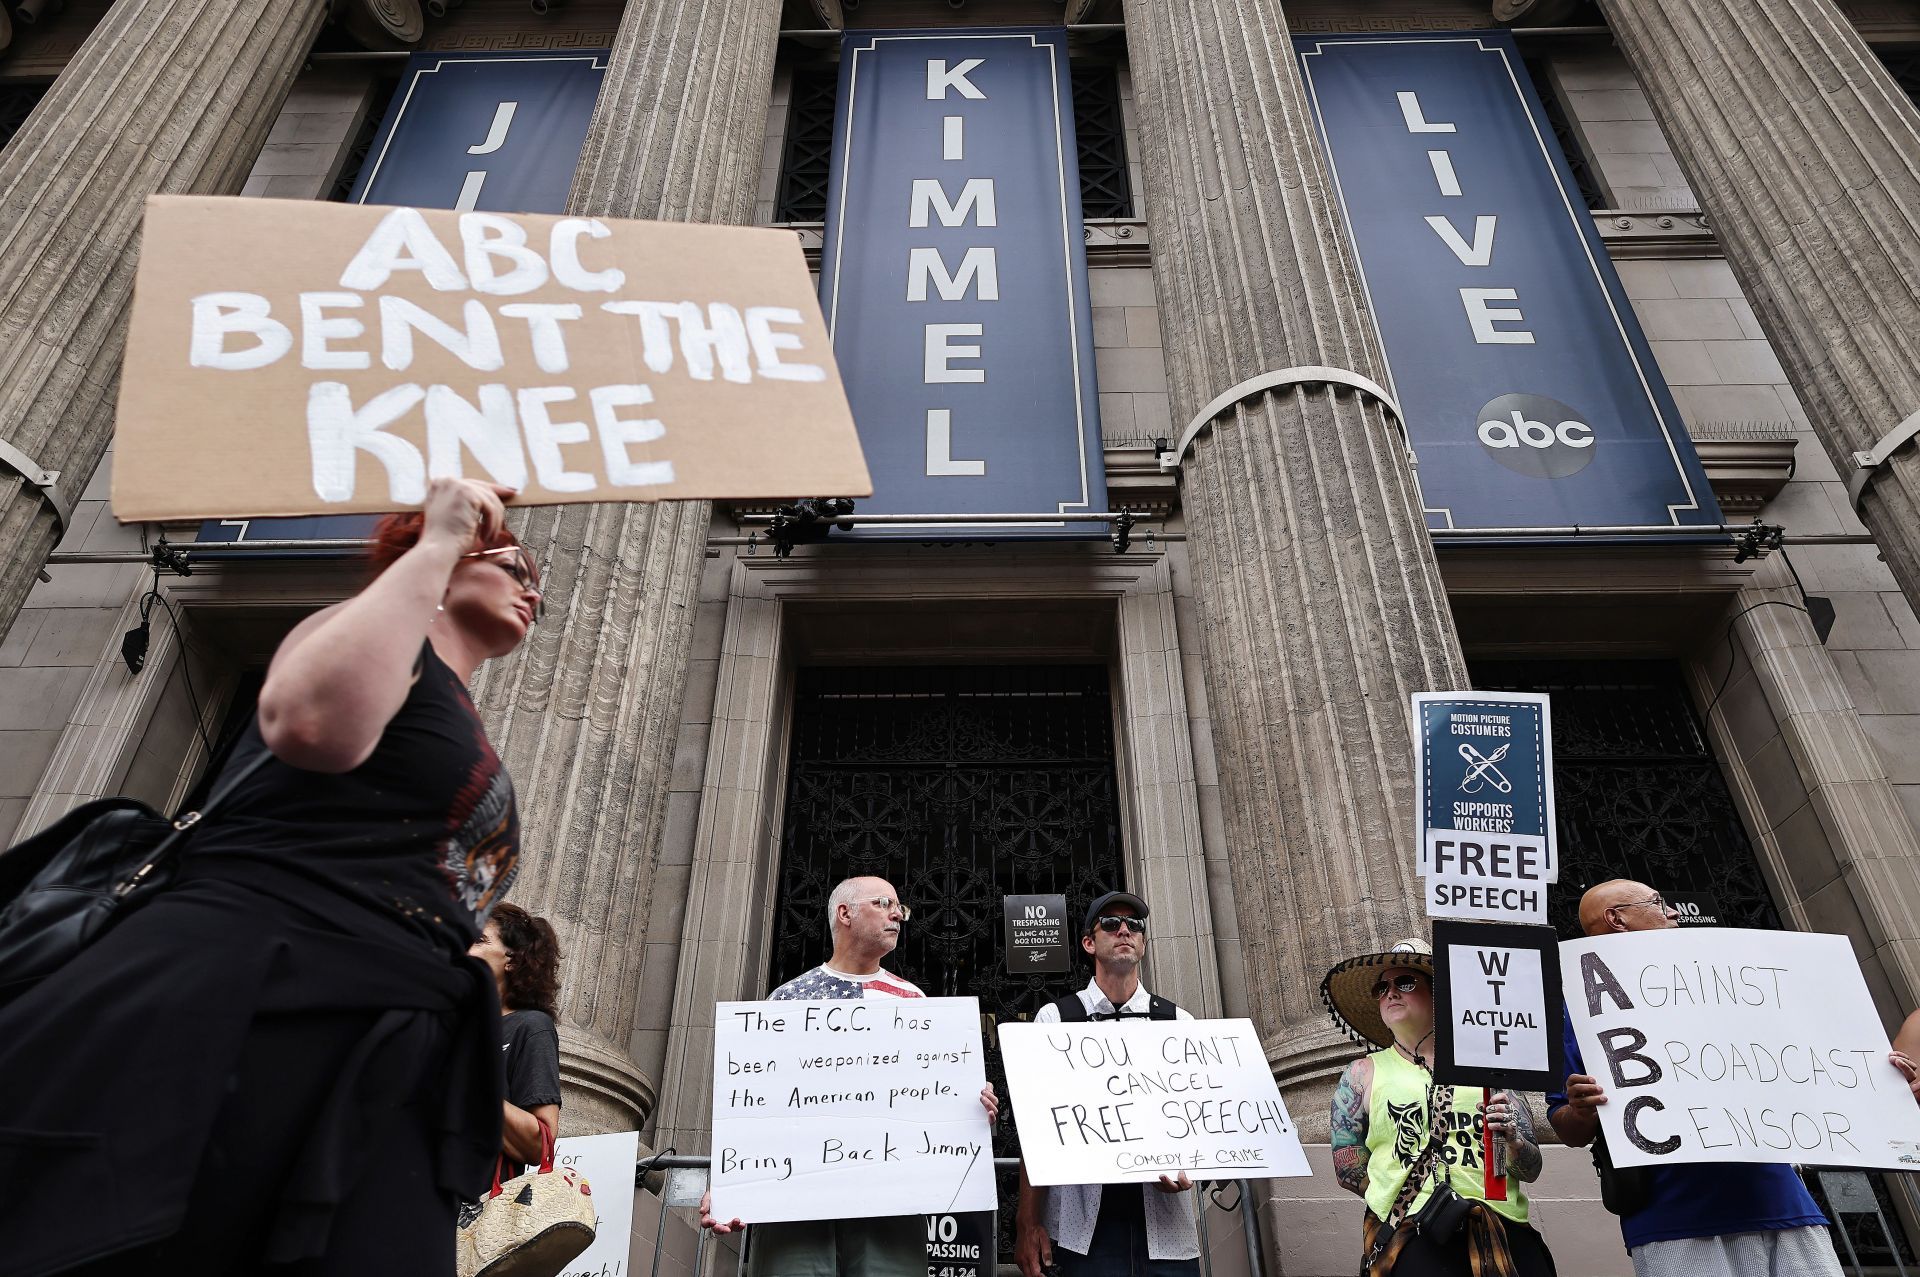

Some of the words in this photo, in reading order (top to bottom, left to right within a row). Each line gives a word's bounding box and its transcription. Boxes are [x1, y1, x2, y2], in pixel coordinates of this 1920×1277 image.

[1396, 91, 1536, 344] LIVE
[340, 207, 626, 295] ABC
[906, 58, 1000, 476] KIMMEL
[190, 291, 582, 374] BENT
[600, 300, 826, 384] THE
[306, 380, 675, 506] KNEE
[1476, 410, 1596, 450] abc
[1450, 713, 1478, 724] MOTION
[1480, 714, 1511, 725] PICTURE
[1450, 724, 1512, 737] COSTUMERS
[1453, 801, 1513, 818] SUPPORTS
[1434, 840, 1539, 881] FREE
[1434, 884, 1538, 912] SPEECH
[1675, 902, 1700, 916] NO
[1012, 918, 1060, 927] TRESPASSING
[1024, 905, 1047, 919] NO
[1677, 915, 1717, 924] ESPASSING
[1014, 937, 1030, 945] 602
[1038, 929, 1060, 937] 41.24
[1477, 950, 1511, 977] W
[1486, 980, 1506, 1006] T
[735, 1011, 786, 1033] The
[804, 1006, 871, 1032] F.C.C.
[893, 1006, 932, 1031] has
[1461, 1009, 1538, 1029] ACTUAL
[1047, 1032, 1133, 1070] YOU
[1493, 1030, 1509, 1056] F
[728, 1051, 777, 1075] been
[799, 1049, 900, 1072] weaponized
[916, 1043, 972, 1069] against
[1596, 1026, 1877, 1092] BROADCAST
[728, 1089, 766, 1108] the
[788, 1087, 875, 1109] American
[889, 1081, 958, 1108] people.
[1106, 1071, 1223, 1096] CANCEL
[1050, 1102, 1144, 1146] FREE
[1161, 1099, 1288, 1139] SPEECH!
[1622, 1095, 1861, 1156] CENSOR
[721, 1147, 793, 1181] Bring
[822, 1132, 901, 1164] Back
[1116, 1151, 1182, 1170] COMEDY
[1215, 1148, 1264, 1164] CRIME
[926, 1243, 980, 1259] PASSING
